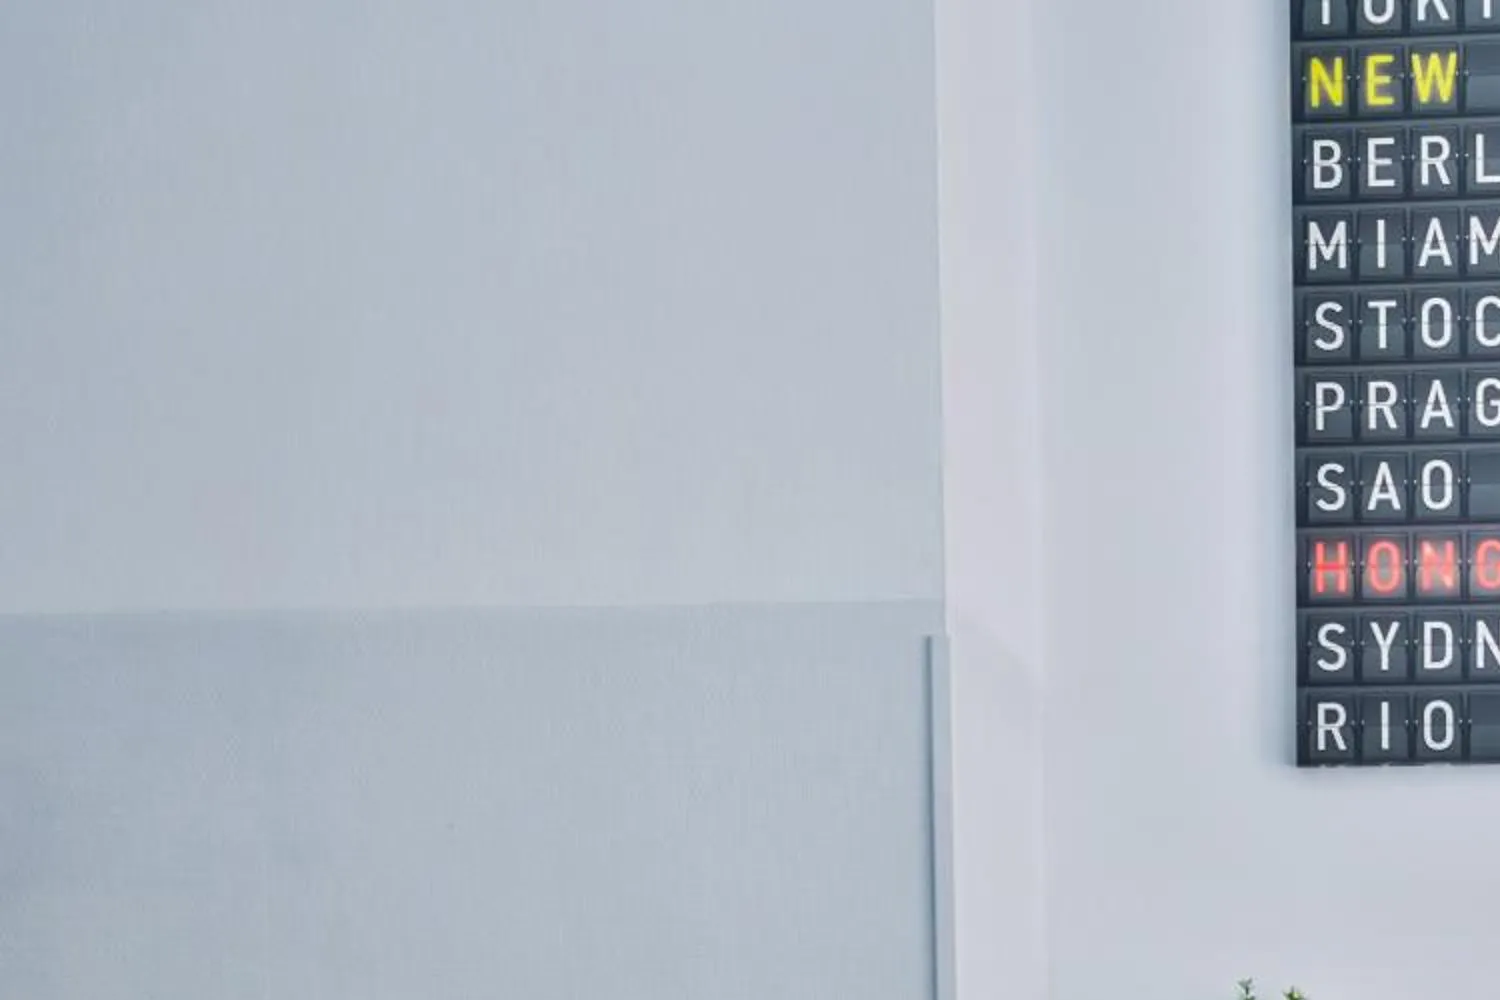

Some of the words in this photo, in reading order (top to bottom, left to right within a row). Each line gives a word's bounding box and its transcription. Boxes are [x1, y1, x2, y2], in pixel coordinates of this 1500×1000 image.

[1309, 52, 1458, 108] NEW
[1316, 459, 1454, 511] SAO
[1316, 700, 1455, 751] RIO
